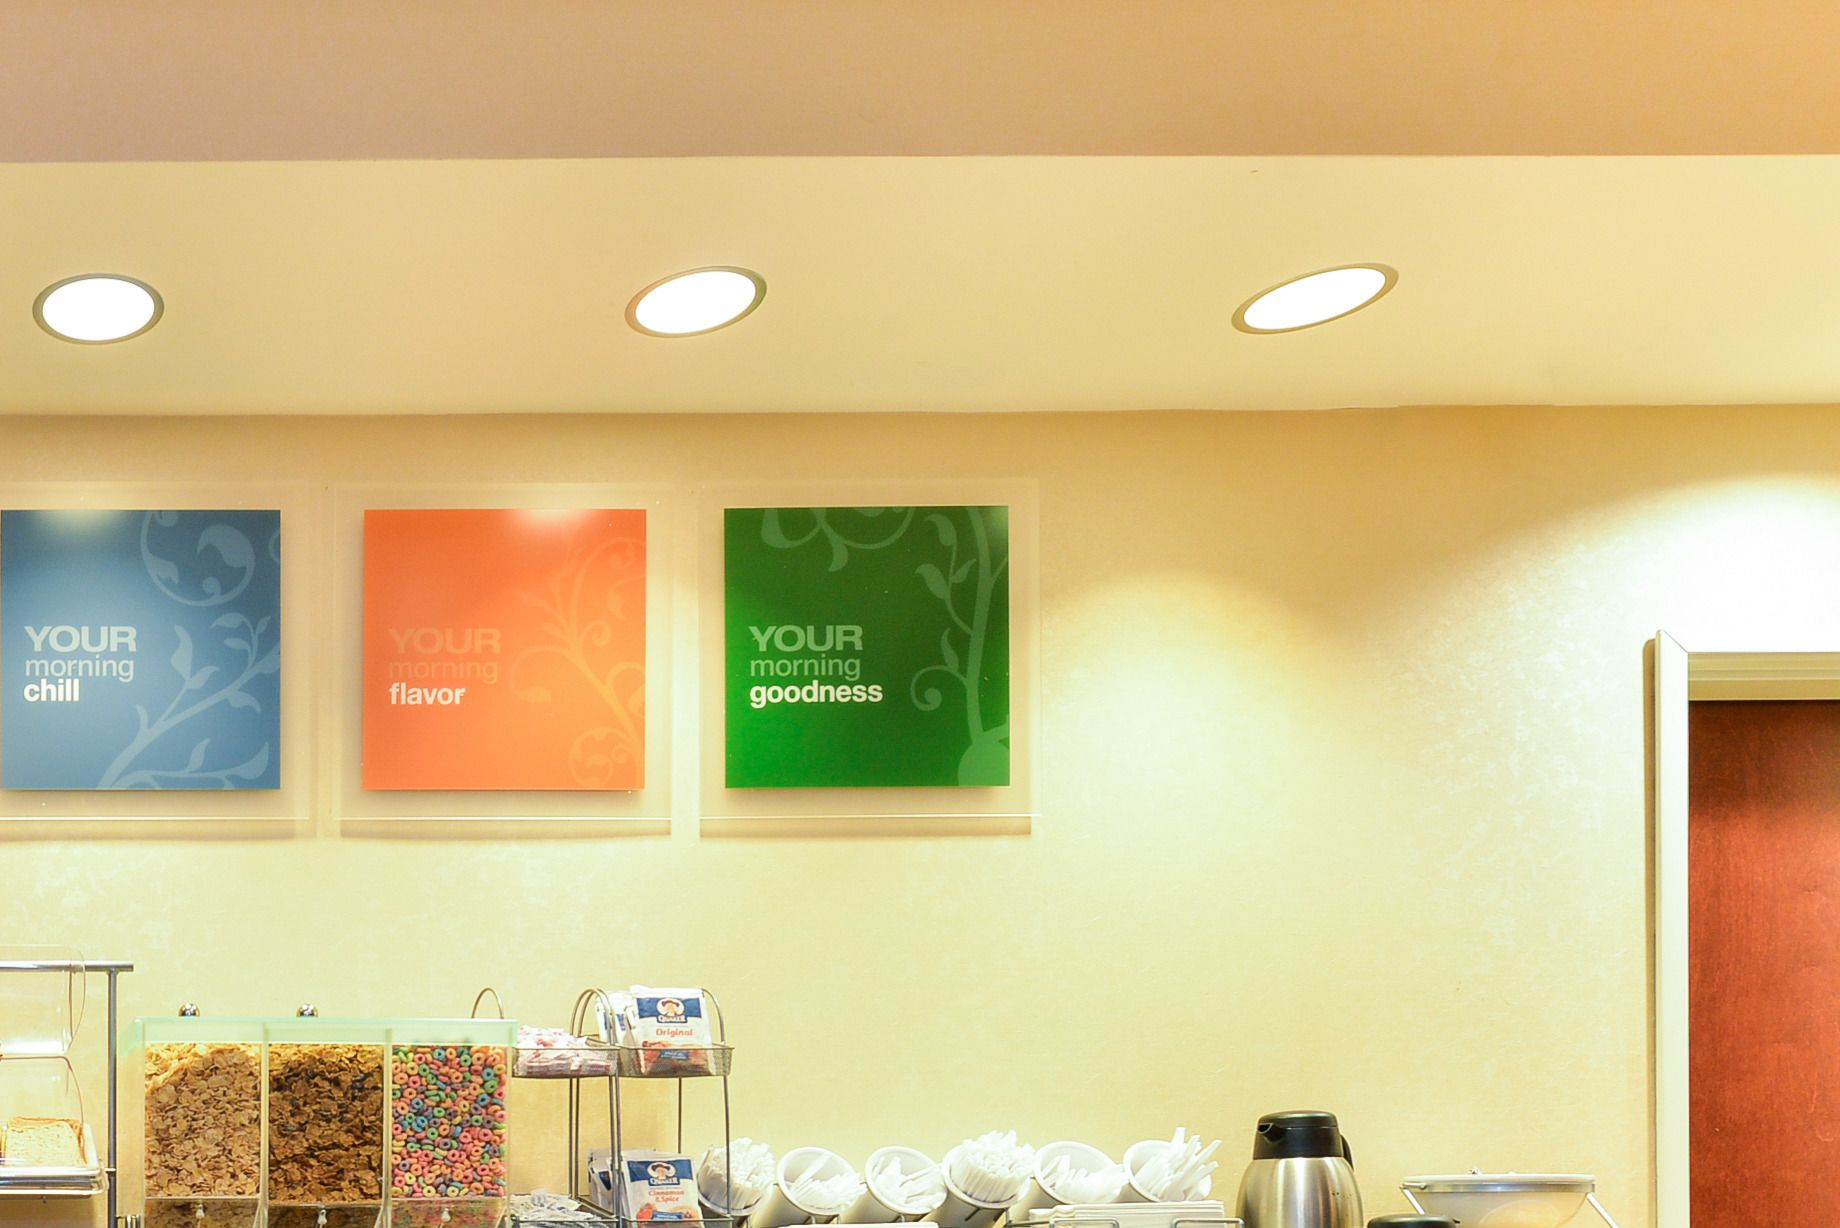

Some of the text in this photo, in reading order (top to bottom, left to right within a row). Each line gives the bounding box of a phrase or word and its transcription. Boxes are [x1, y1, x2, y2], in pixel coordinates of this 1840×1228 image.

[24, 625, 137, 653] YOUR
[388, 627, 502, 655] YOUR
[748, 624, 863, 652] YOUR
[25, 654, 134, 682] morning
[389, 656, 498, 684] morning
[750, 653, 860, 681] morning
[23, 678, 80, 702] chill
[389, 682, 466, 705] flavor
[749, 680, 884, 709] goodness
[656, 1028, 693, 1038] Original
